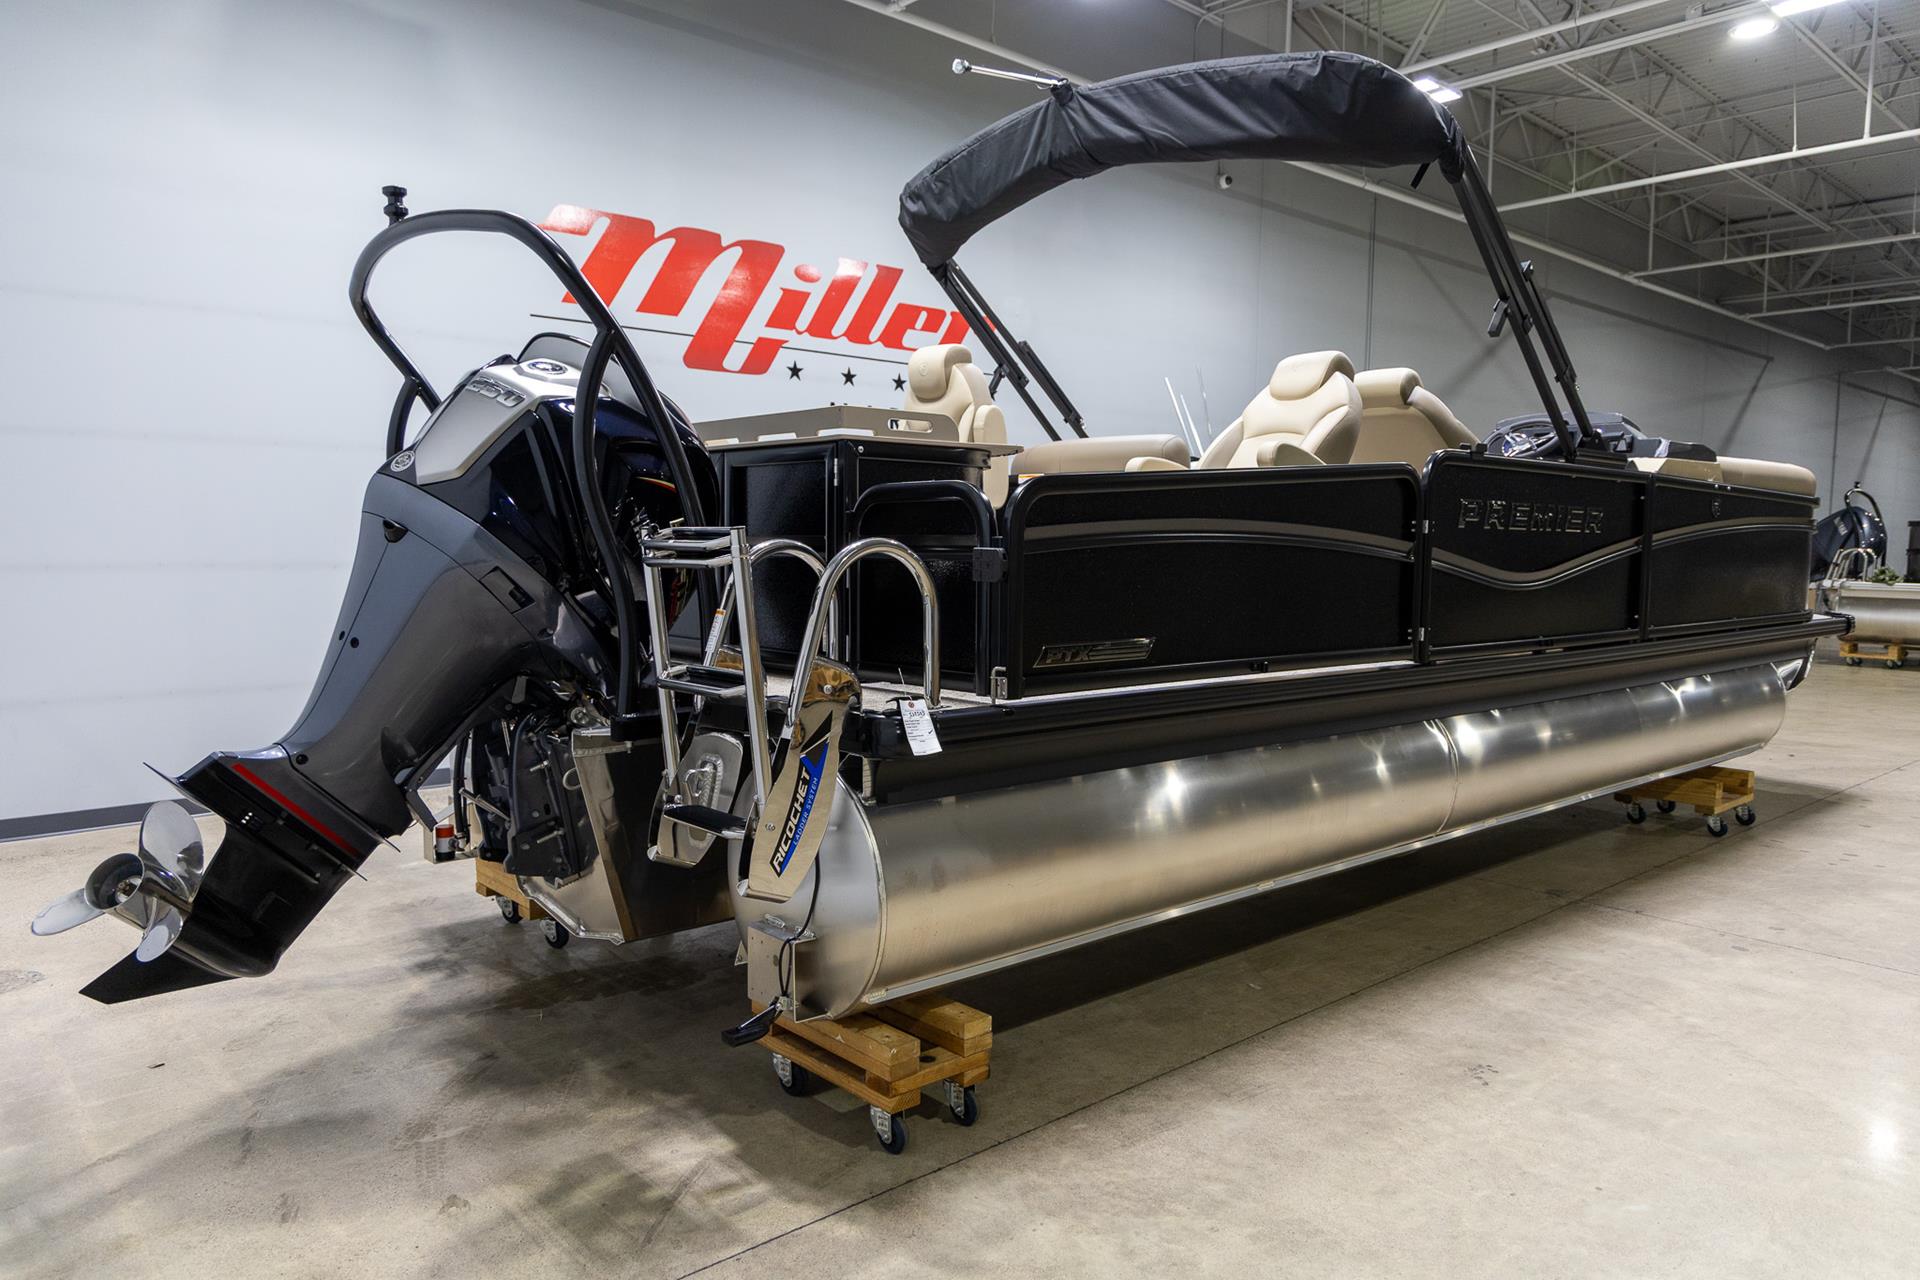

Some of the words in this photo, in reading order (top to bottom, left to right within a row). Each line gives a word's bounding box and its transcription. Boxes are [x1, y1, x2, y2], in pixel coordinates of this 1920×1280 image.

[1457, 498, 1604, 534] PREMIER
[772, 766, 811, 873] RICOCHET
[793, 811, 809, 846] LADDER
[806, 776, 819, 809] SYSTEM
